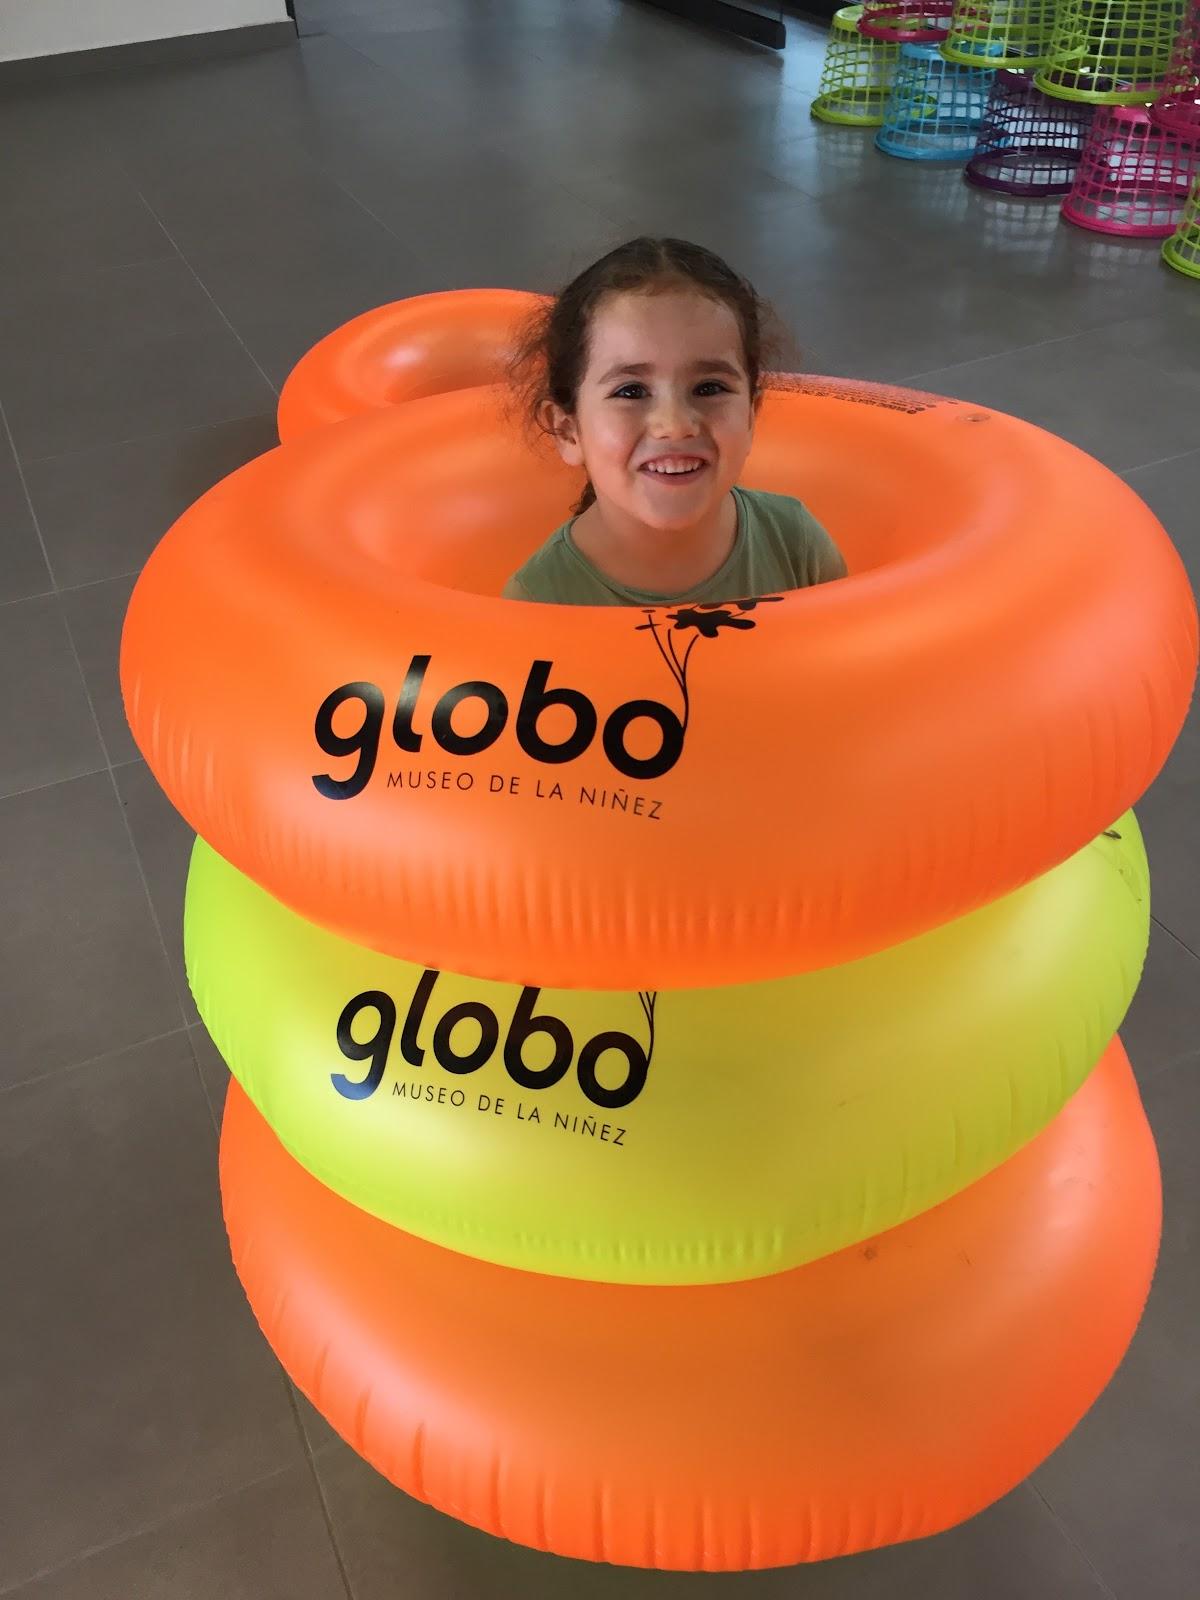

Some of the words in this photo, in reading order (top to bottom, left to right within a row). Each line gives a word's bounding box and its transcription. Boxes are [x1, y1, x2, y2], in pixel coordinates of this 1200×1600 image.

[312, 654, 685, 800] globo
[386, 772, 475, 791] MUSEO
[489, 776, 521, 796] DE
[536, 780, 565, 802] LA
[580, 788, 663, 820] NIÑEZ
[330, 969, 651, 1109] globo
[392, 1081, 465, 1107] MUSEO
[478, 1094, 505, 1115] DE
[517, 1103, 541, 1124] LA
[554, 1112, 627, 1146] NIÑEZ
